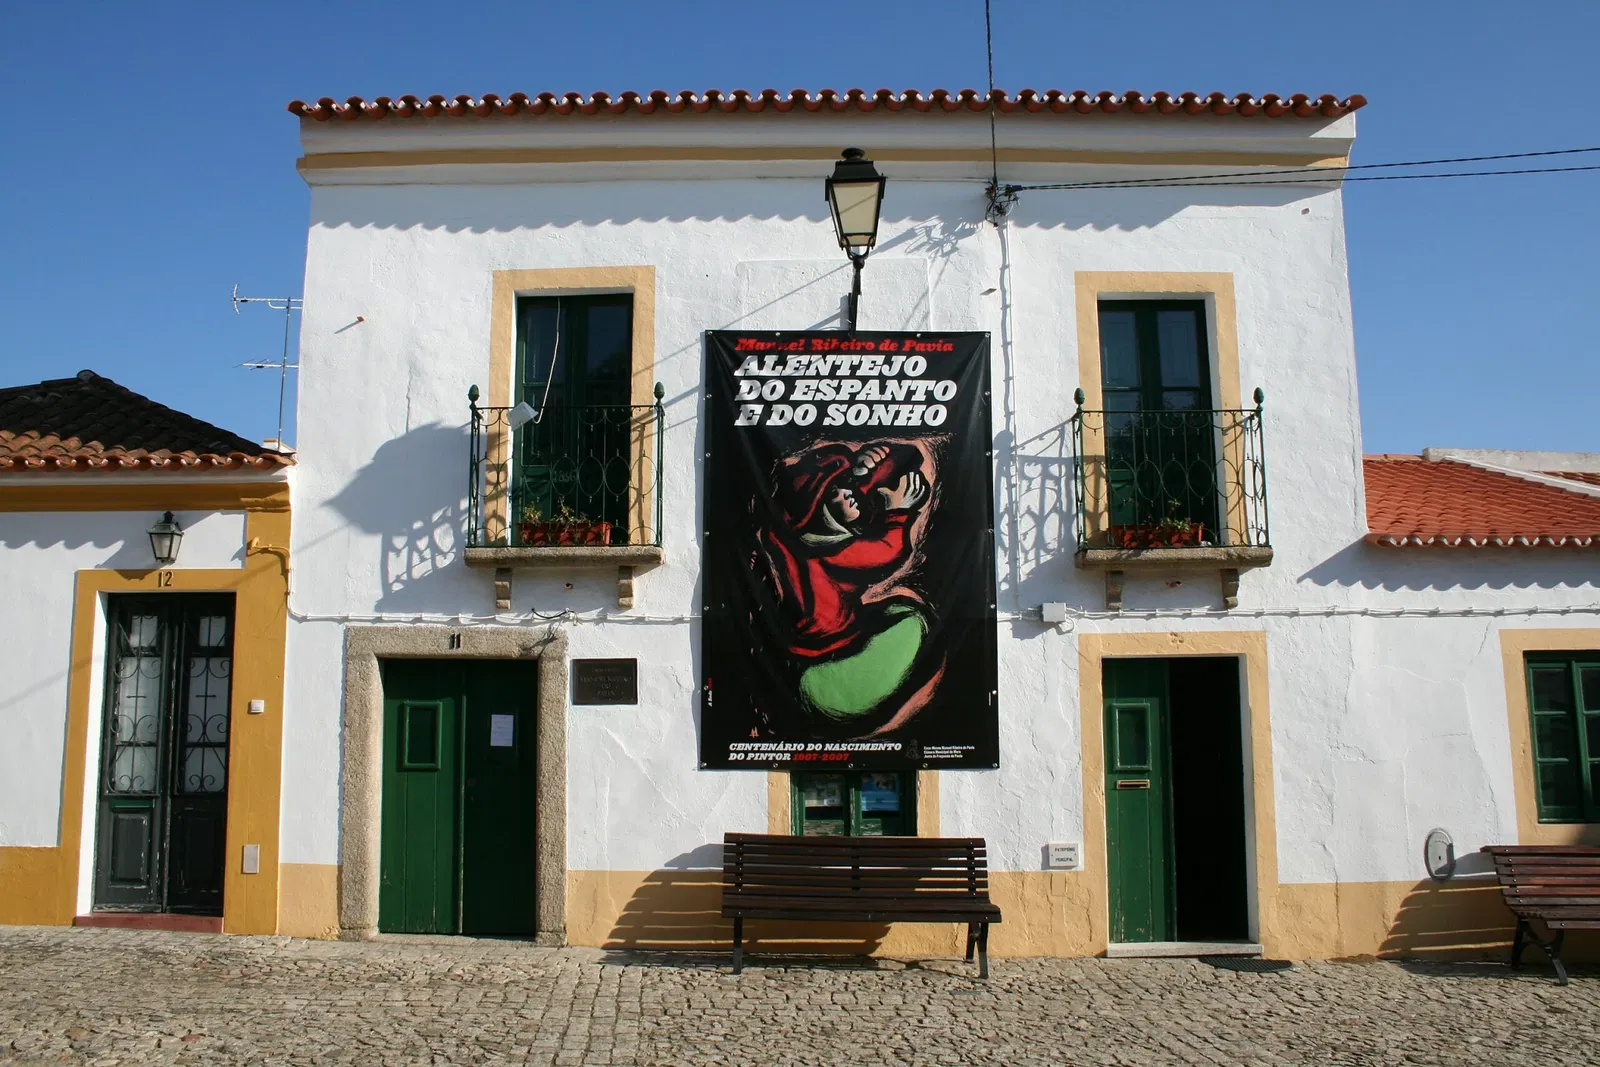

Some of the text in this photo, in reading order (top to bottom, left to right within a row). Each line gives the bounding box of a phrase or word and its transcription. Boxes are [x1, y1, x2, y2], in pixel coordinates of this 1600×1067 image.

[810, 338, 875, 351] Ribeiro
[878, 339, 898, 351] de
[902, 339, 954, 352] Pavia
[733, 354, 928, 377] ALENTEJO
[733, 378, 958, 402] DO ESPANTO
[733, 403, 948, 427] E DO SONHO
[157, 571, 174, 588] 12
[448, 633, 461, 650] 11
[728, 740, 903, 751] CENTENÁRIO DO NASCIMENTO
[728, 752, 851, 761] DO PINTOR 1907-2007
